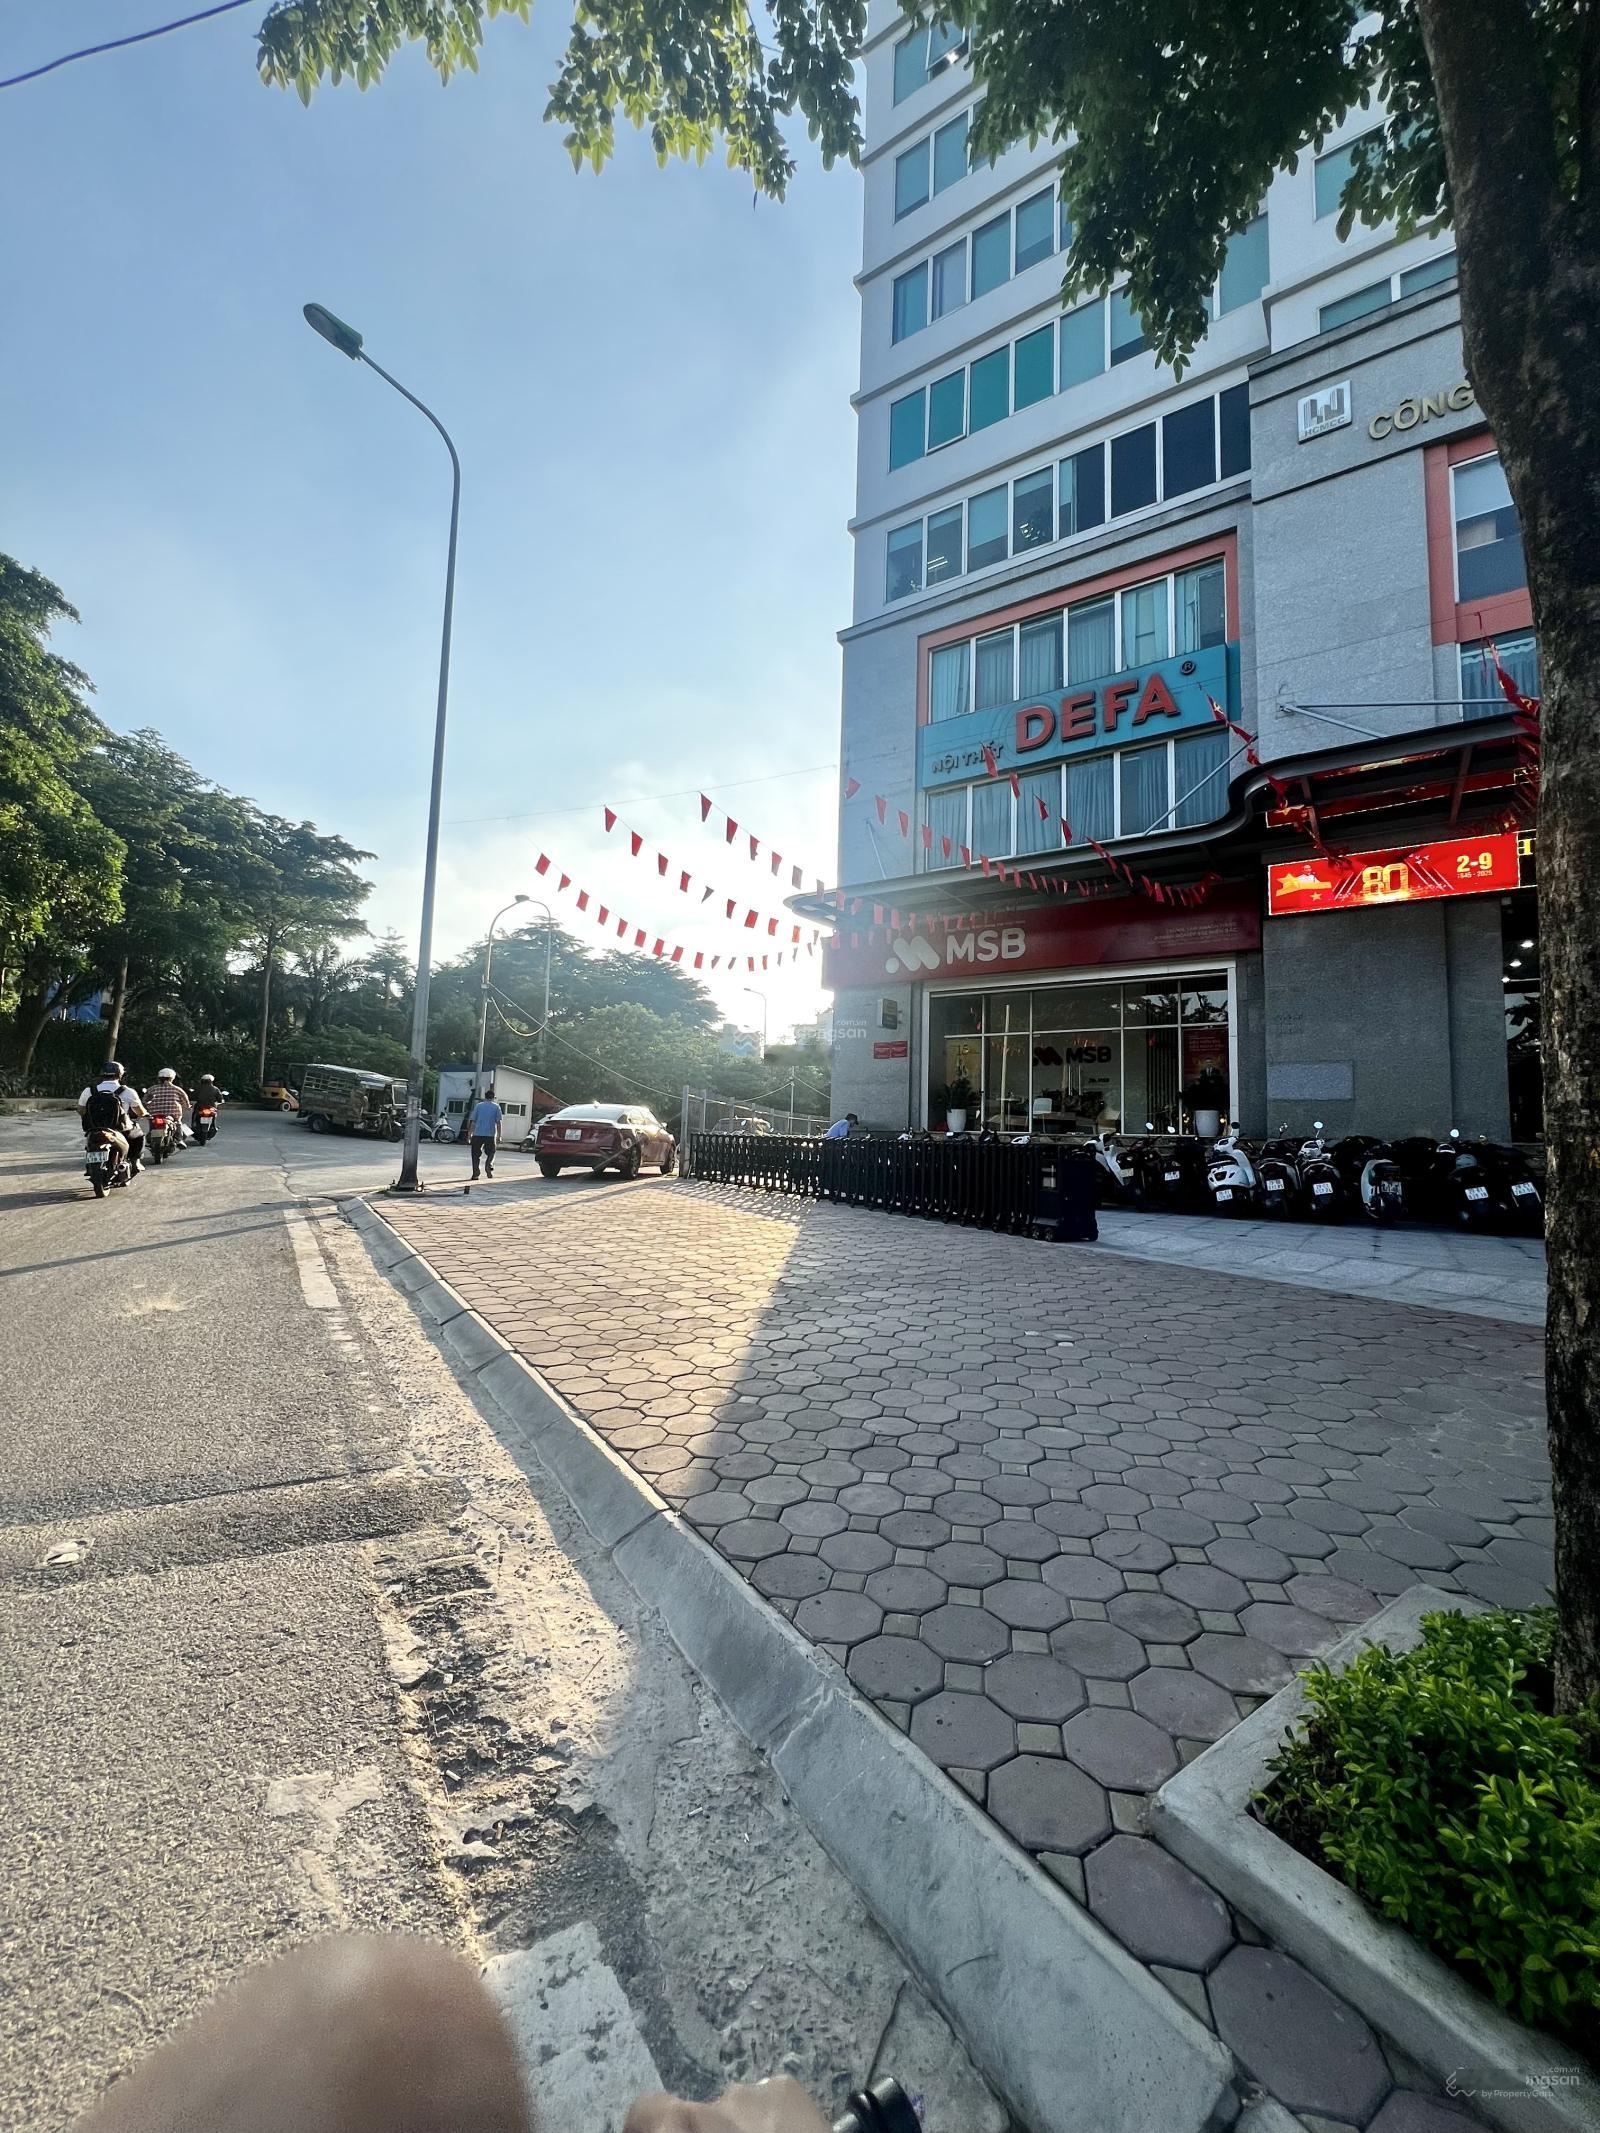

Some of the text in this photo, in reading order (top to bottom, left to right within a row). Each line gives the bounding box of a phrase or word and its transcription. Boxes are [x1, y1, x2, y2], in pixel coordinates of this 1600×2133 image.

[1369, 380, 1475, 440] CÔNG
[1016, 674, 1182, 752] DEFA
[1362, 863, 1409, 898] 80
[1456, 852, 1493, 873] 2-9
[946, 927, 1026, 965] MSB
[1066, 1046, 1112, 1064] MSB
